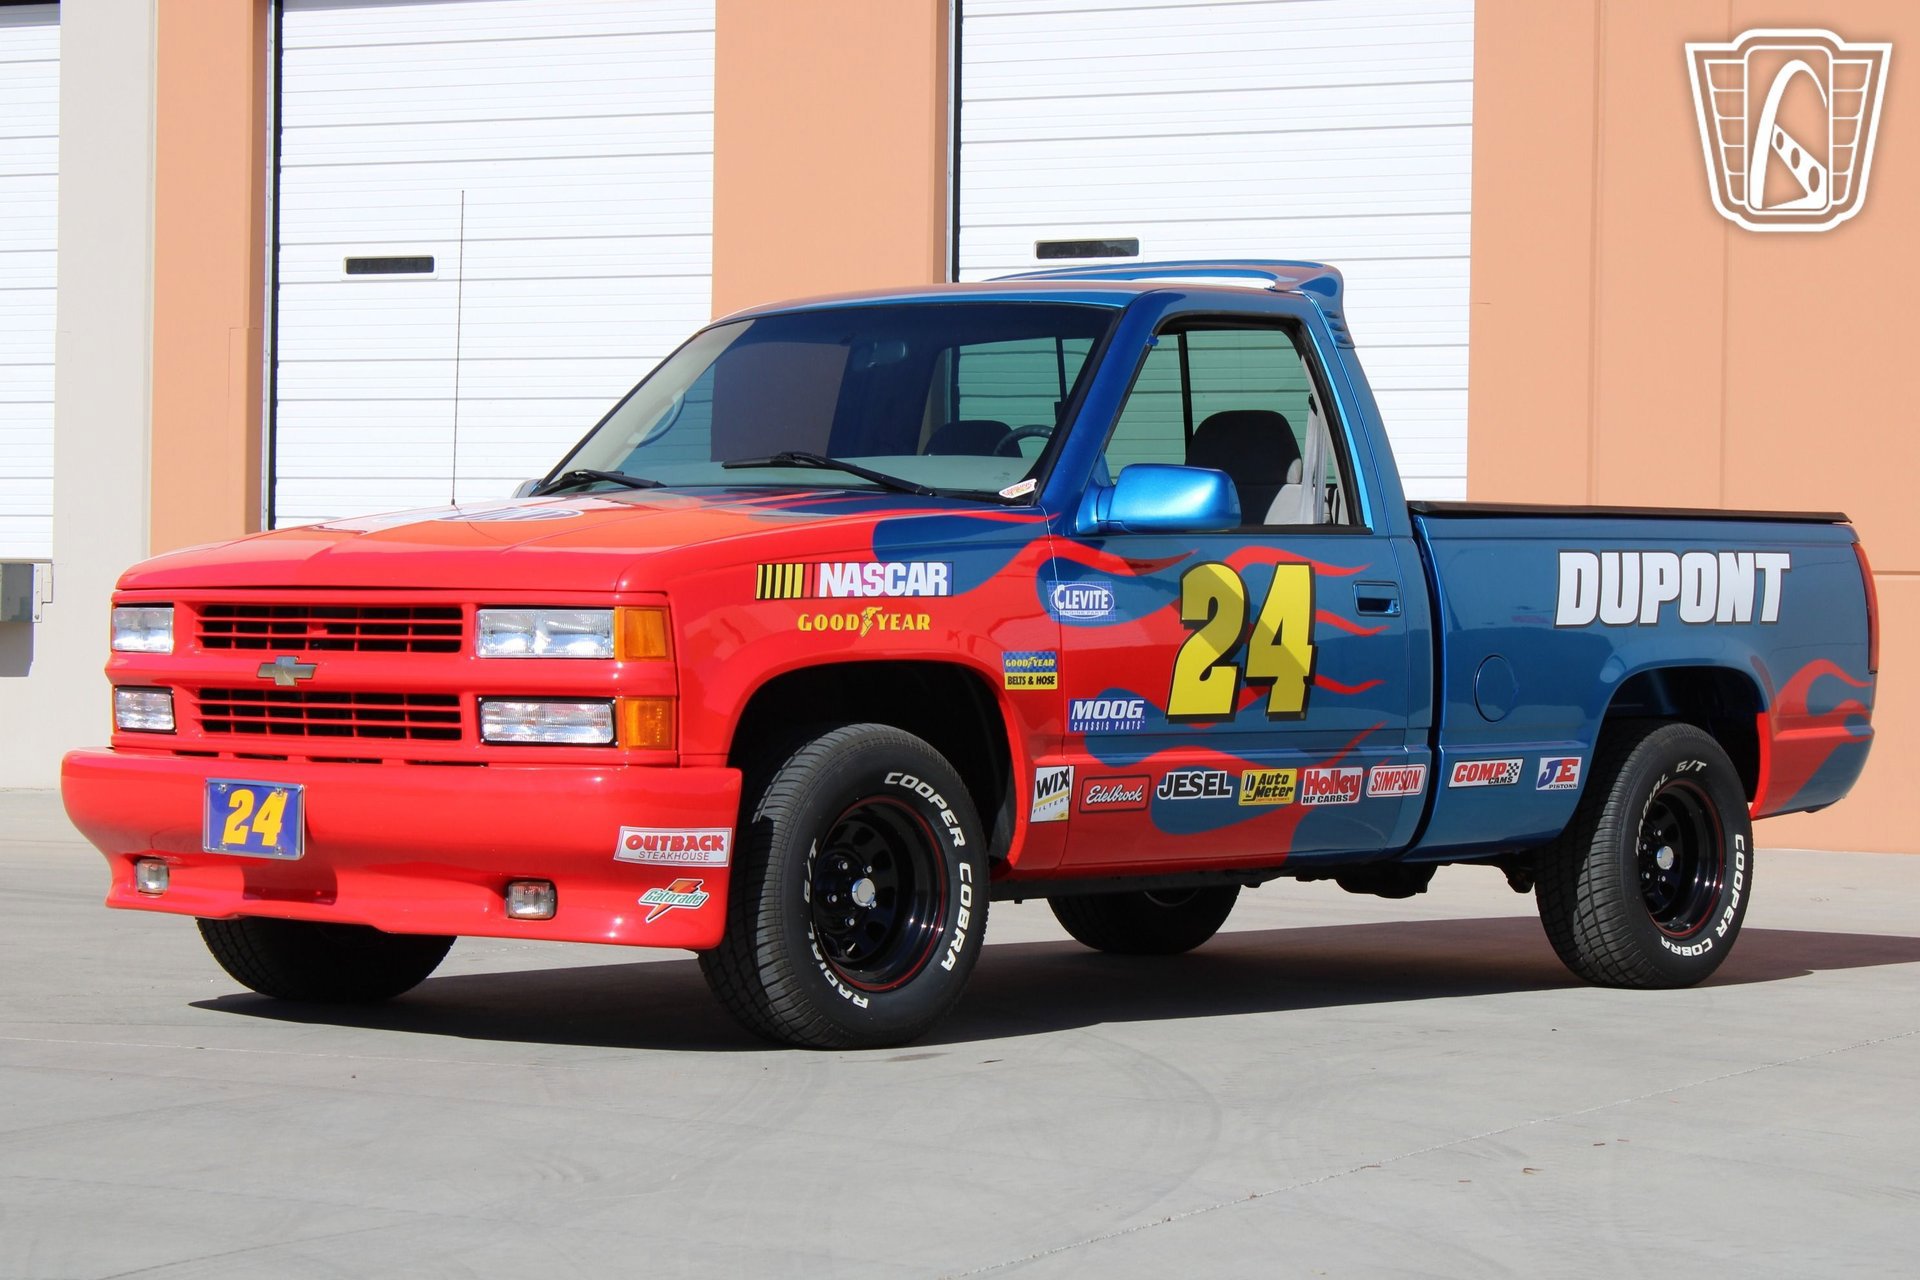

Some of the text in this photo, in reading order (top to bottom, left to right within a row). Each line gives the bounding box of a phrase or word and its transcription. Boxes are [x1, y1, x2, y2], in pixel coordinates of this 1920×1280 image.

[819, 562, 947, 597] NASCAR
[1555, 551, 1791, 627] DUPONT
[1054, 585, 1109, 609] CLEVITE
[1166, 561, 1316, 722] 24
[1007, 675, 1055, 685] BELTS & HOSE
[1071, 700, 1145, 720] MOOG
[1073, 721, 1141, 731] CHASSIS PARTS
[1454, 762, 1508, 783] COMP
[1537, 759, 1579, 788] JE
[1676, 760, 1707, 773] G/T
[1036, 768, 1070, 799] WIX
[1157, 771, 1232, 799] JESEL
[1258, 773, 1289, 785] Auto
[1303, 770, 1361, 801] Holley
[1372, 769, 1422, 792] SIMPSON
[1488, 776, 1513, 785] CAMS
[1085, 784, 1143, 804] Edelbrock
[1256, 786, 1293, 798] Meter
[1303, 795, 1348, 804] HP CARBS
[1033, 796, 1070, 814] FILTERS
[223, 789, 288, 846] 24
[625, 834, 725, 852] OUTBACK
[639, 851, 710, 861] STEAKHOUSE
[885, 772, 973, 972] COOPER COBRA
[645, 889, 706, 905] Gatorade
[1661, 834, 1745, 957] COOPER COBRA
